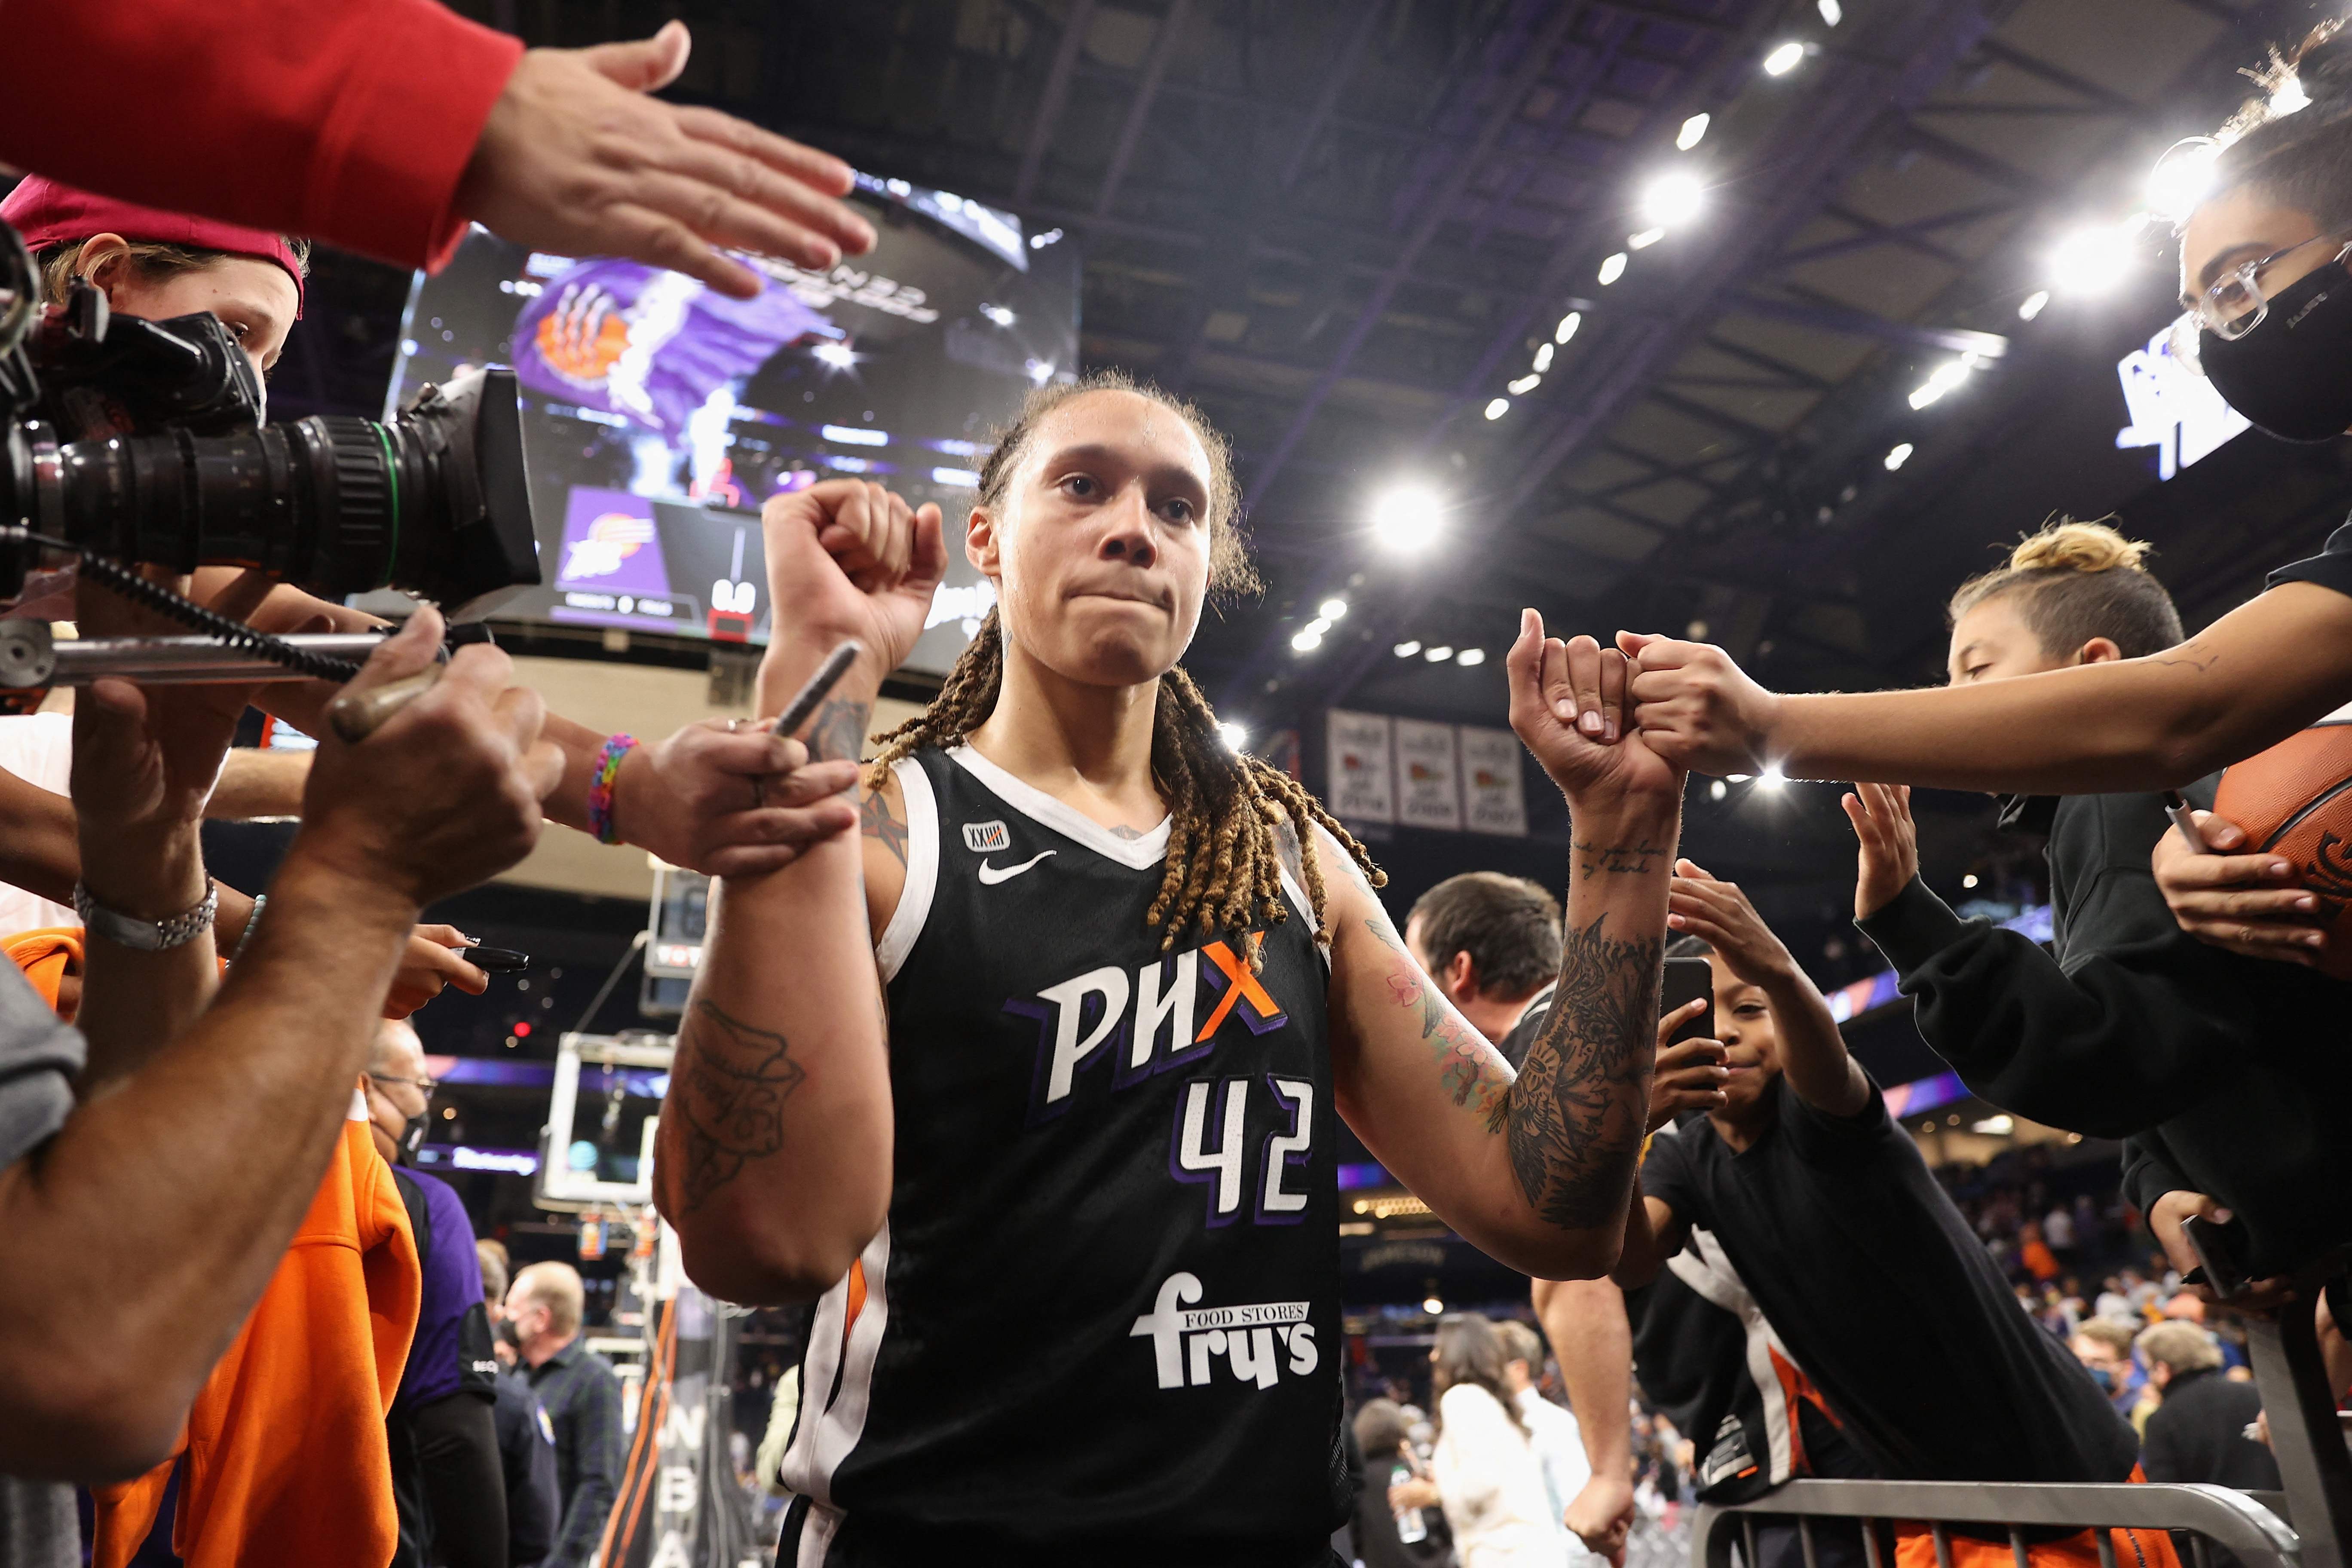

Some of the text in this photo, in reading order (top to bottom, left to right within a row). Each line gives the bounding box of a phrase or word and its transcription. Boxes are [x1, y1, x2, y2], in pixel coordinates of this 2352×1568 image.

[1037, 931, 1280, 1103] PHX
[1180, 1079, 1314, 1214] 42
[1129, 1271, 1318, 1390] fry's
[1185, 1304, 1304, 1328] FOOD STORES
[649, 1404, 708, 1568] NBA
